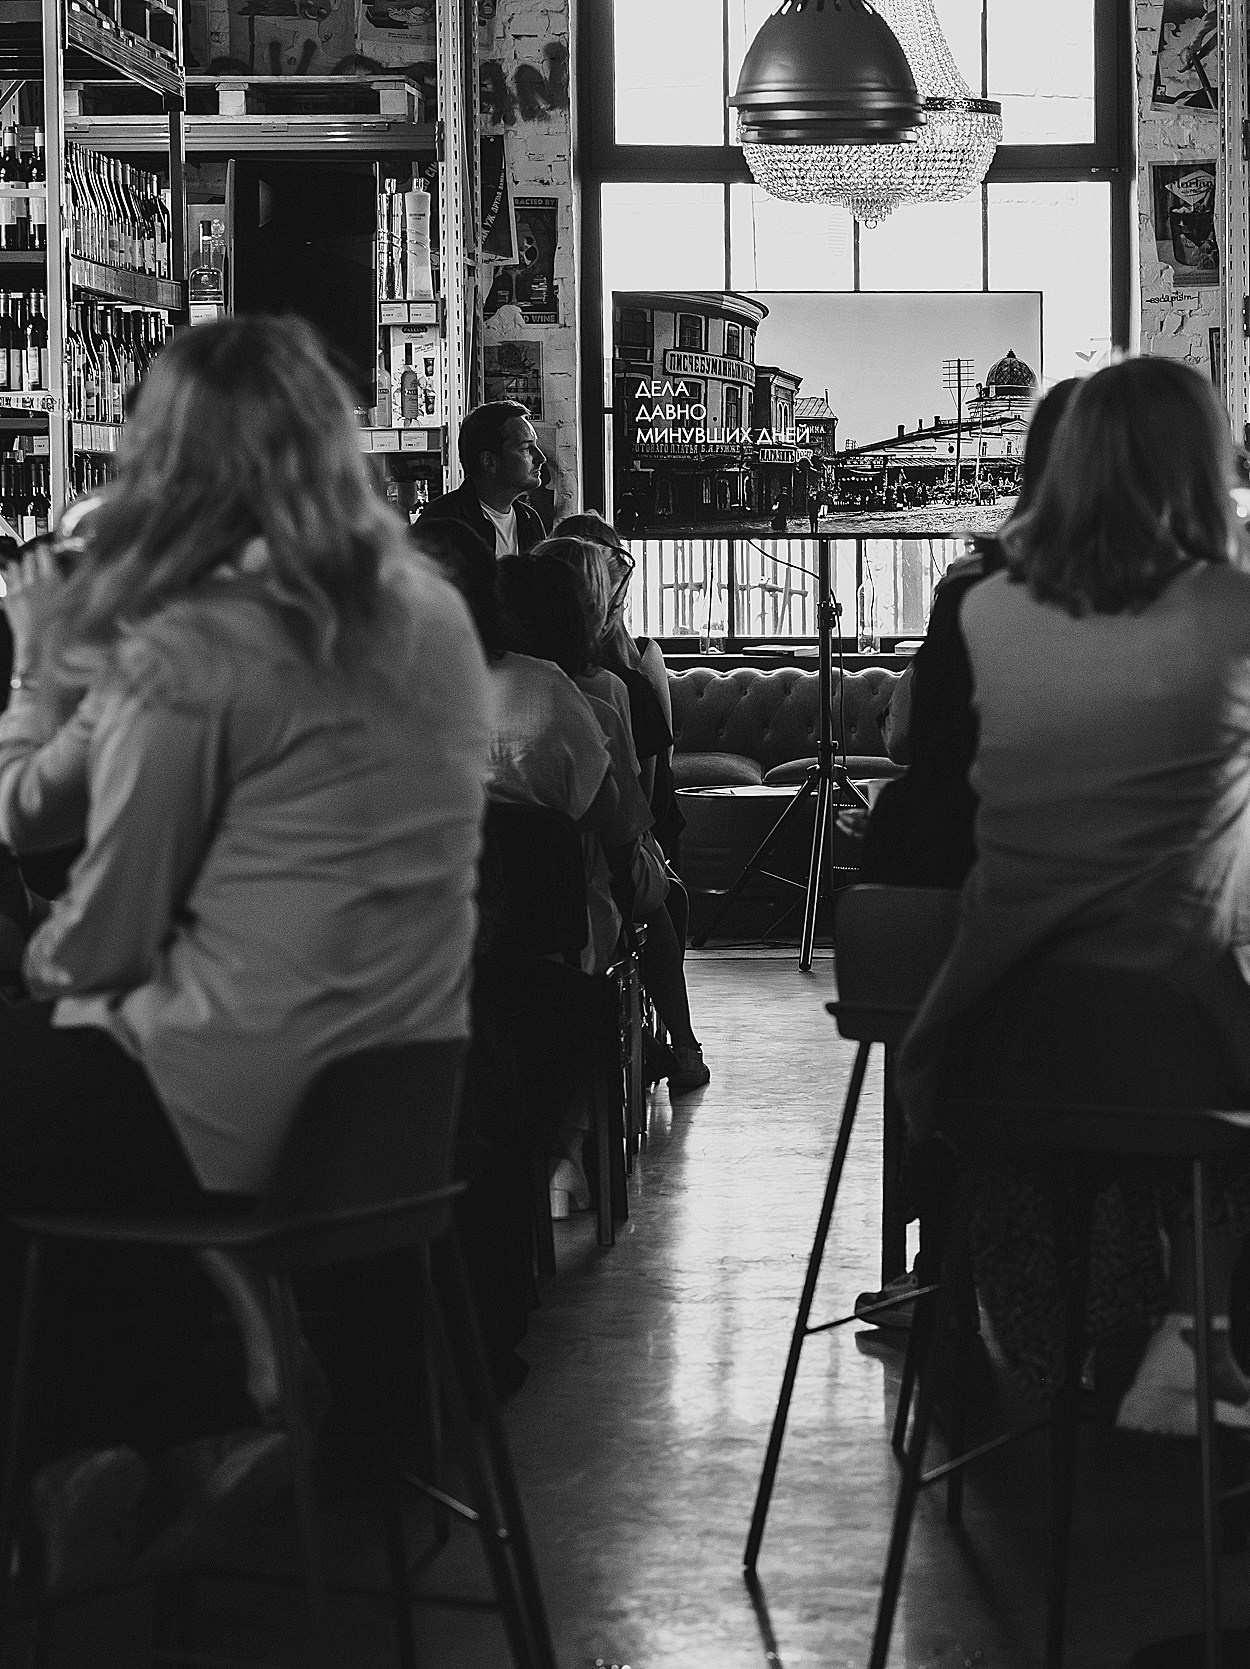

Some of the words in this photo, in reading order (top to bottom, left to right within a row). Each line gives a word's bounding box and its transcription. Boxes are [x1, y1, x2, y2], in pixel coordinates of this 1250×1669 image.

[635, 381, 689, 398] ДЕЛА
[635, 404, 707, 422] ДАВНО
[636, 427, 752, 444] МИНУВШИХ
[756, 423, 810, 445] ДНЕЙ
